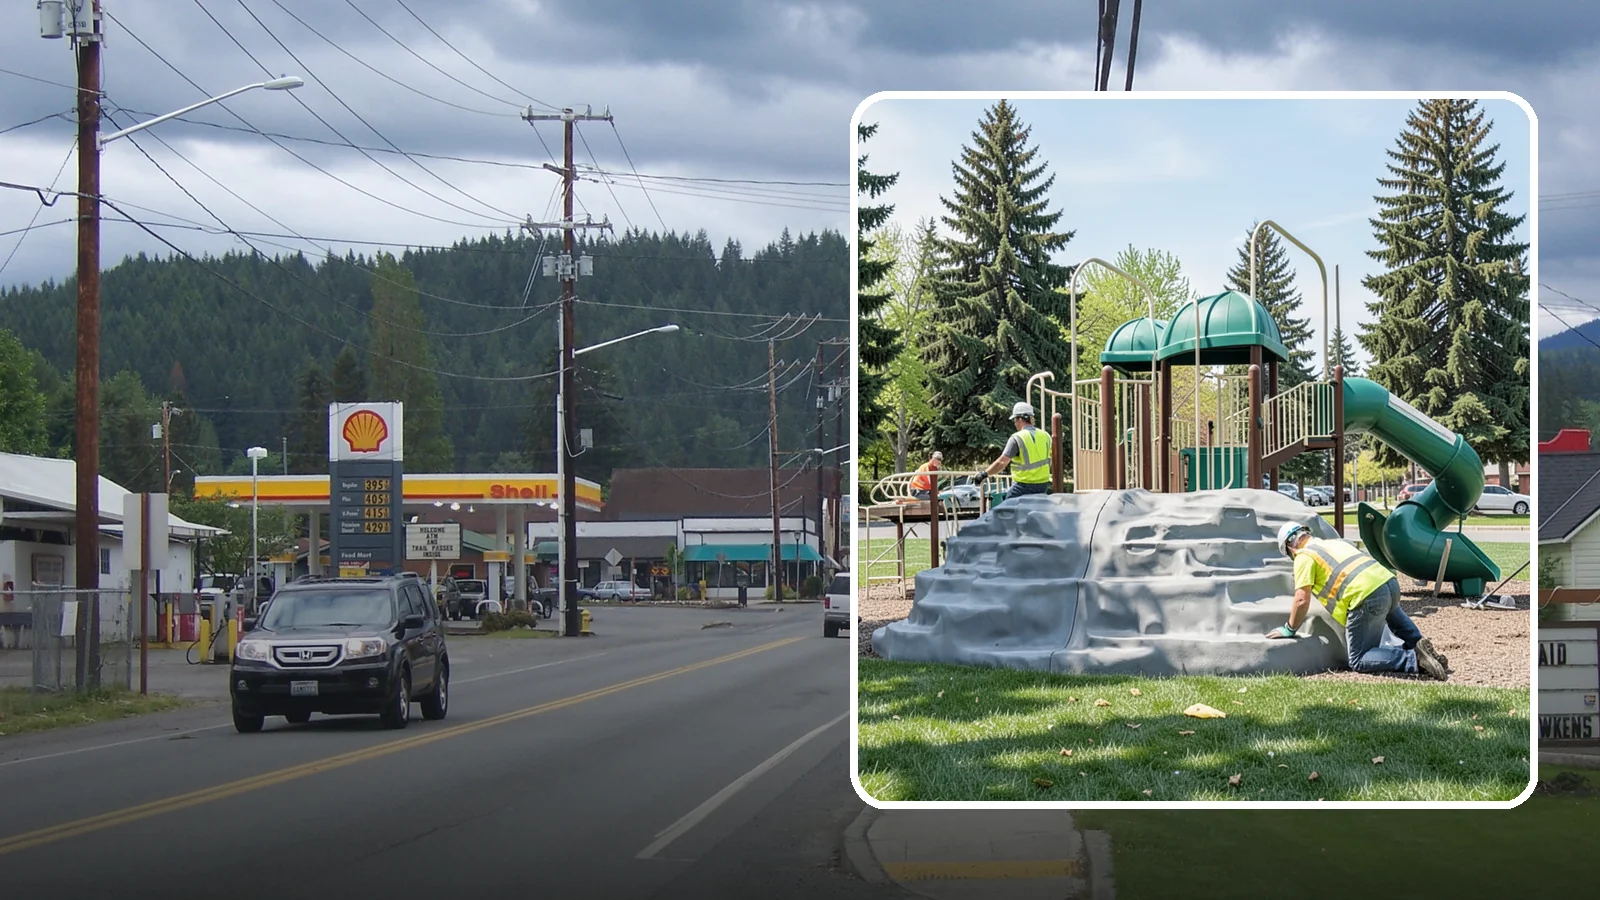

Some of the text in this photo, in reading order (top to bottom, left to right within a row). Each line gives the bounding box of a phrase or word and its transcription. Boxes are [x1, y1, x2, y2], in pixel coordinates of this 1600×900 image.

[366, 480, 383, 490] 395
[490, 484, 547, 499] Shell
[366, 494, 383, 504] 405
[366, 508, 383, 518] 415
[366, 522, 383, 532] 429
